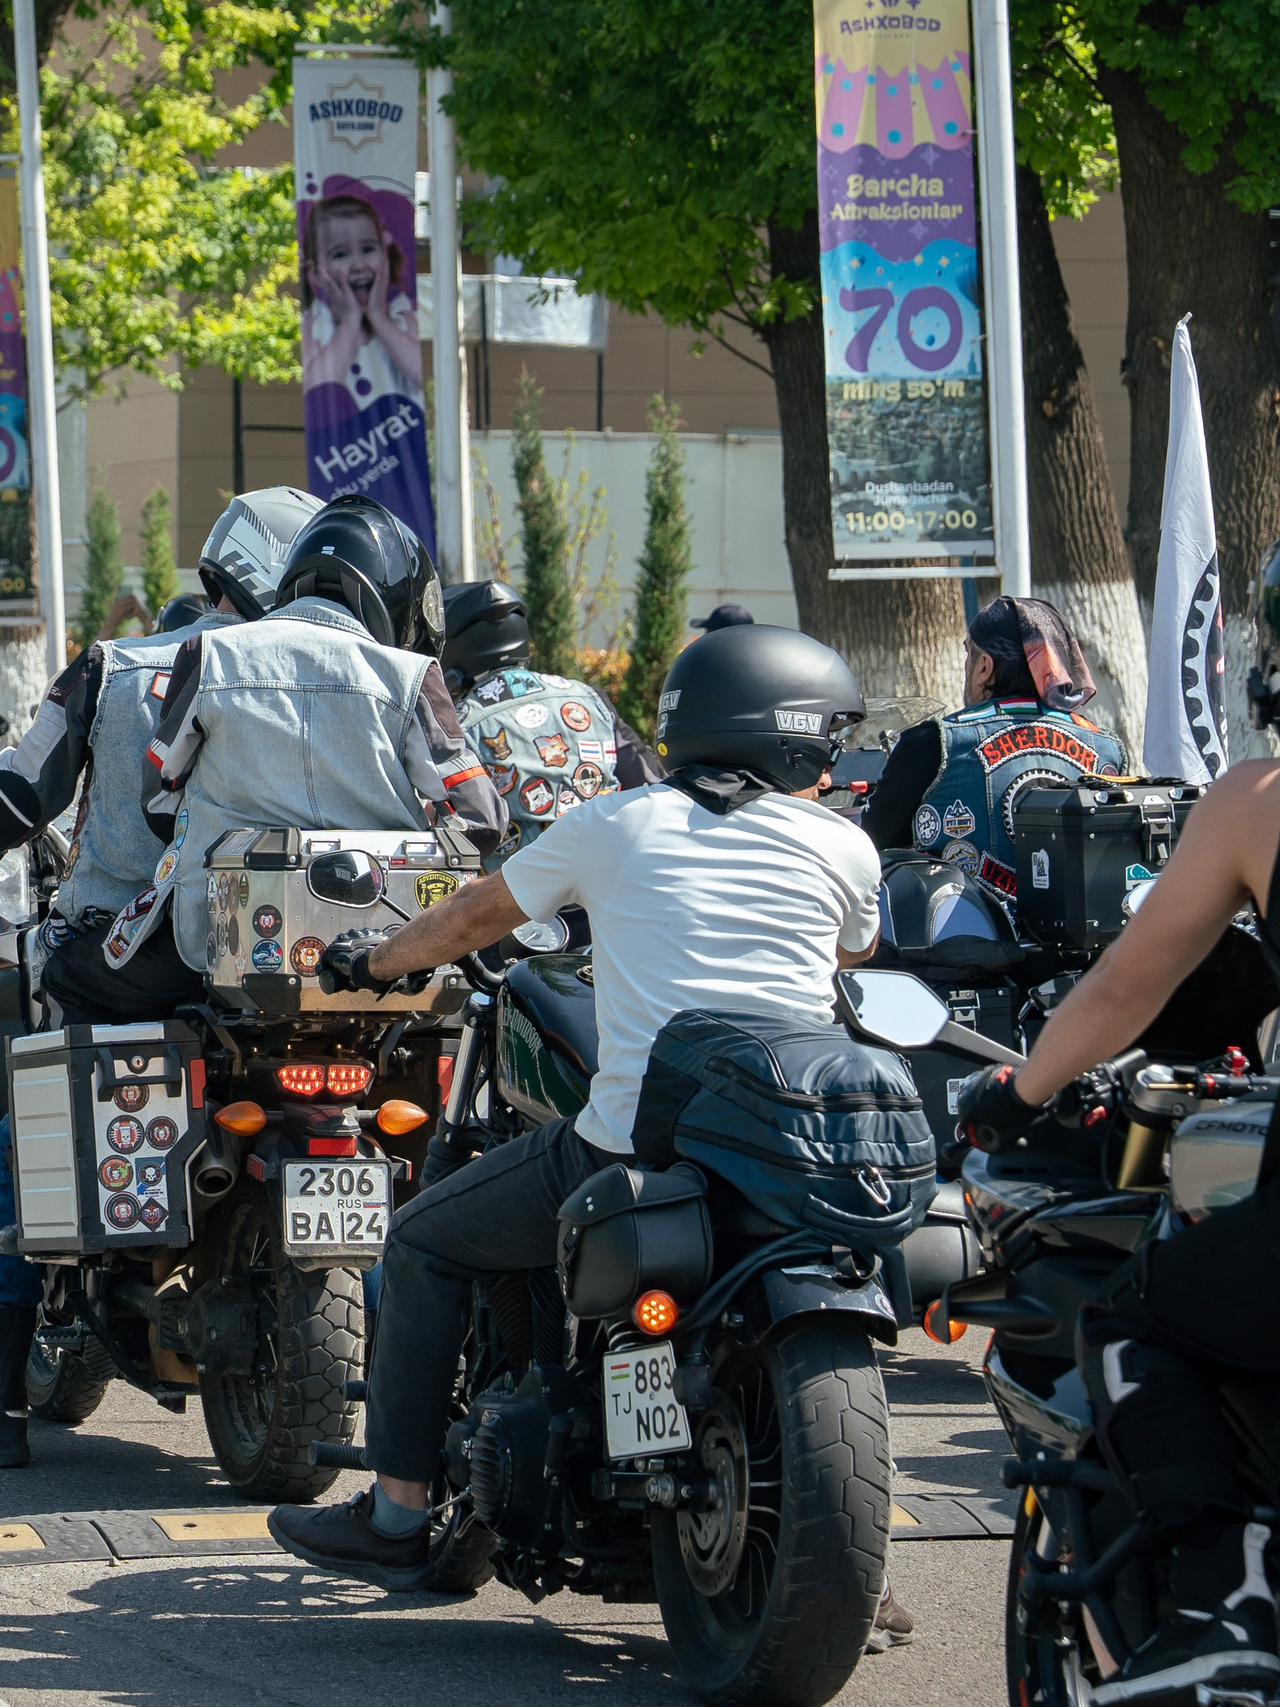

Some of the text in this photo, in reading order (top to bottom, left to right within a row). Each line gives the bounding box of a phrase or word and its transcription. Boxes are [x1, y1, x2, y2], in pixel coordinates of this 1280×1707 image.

[309, 99, 403, 123] ASHXOBOD
[846, 173, 944, 199] Barcha
[830, 202, 963, 222] Attraksionlar
[838, 285, 963, 373] 70
[314, 403, 420, 483] Hayrat
[845, 509, 977, 532] 11:00-17:00
[658, 689, 682, 714] GV
[774, 710, 823, 735] VGV
[982, 726, 1095, 772] SHERDOR
[981, 857, 1017, 896] UZB
[299, 1167, 375, 1197] 2306
[337, 1199, 362, 1209] RUS
[291, 1211, 383, 1241] BA 24
[634, 1355, 673, 1394] 883
[611, 1391, 632, 1416] TJ
[635, 1403, 681, 1443] N02
